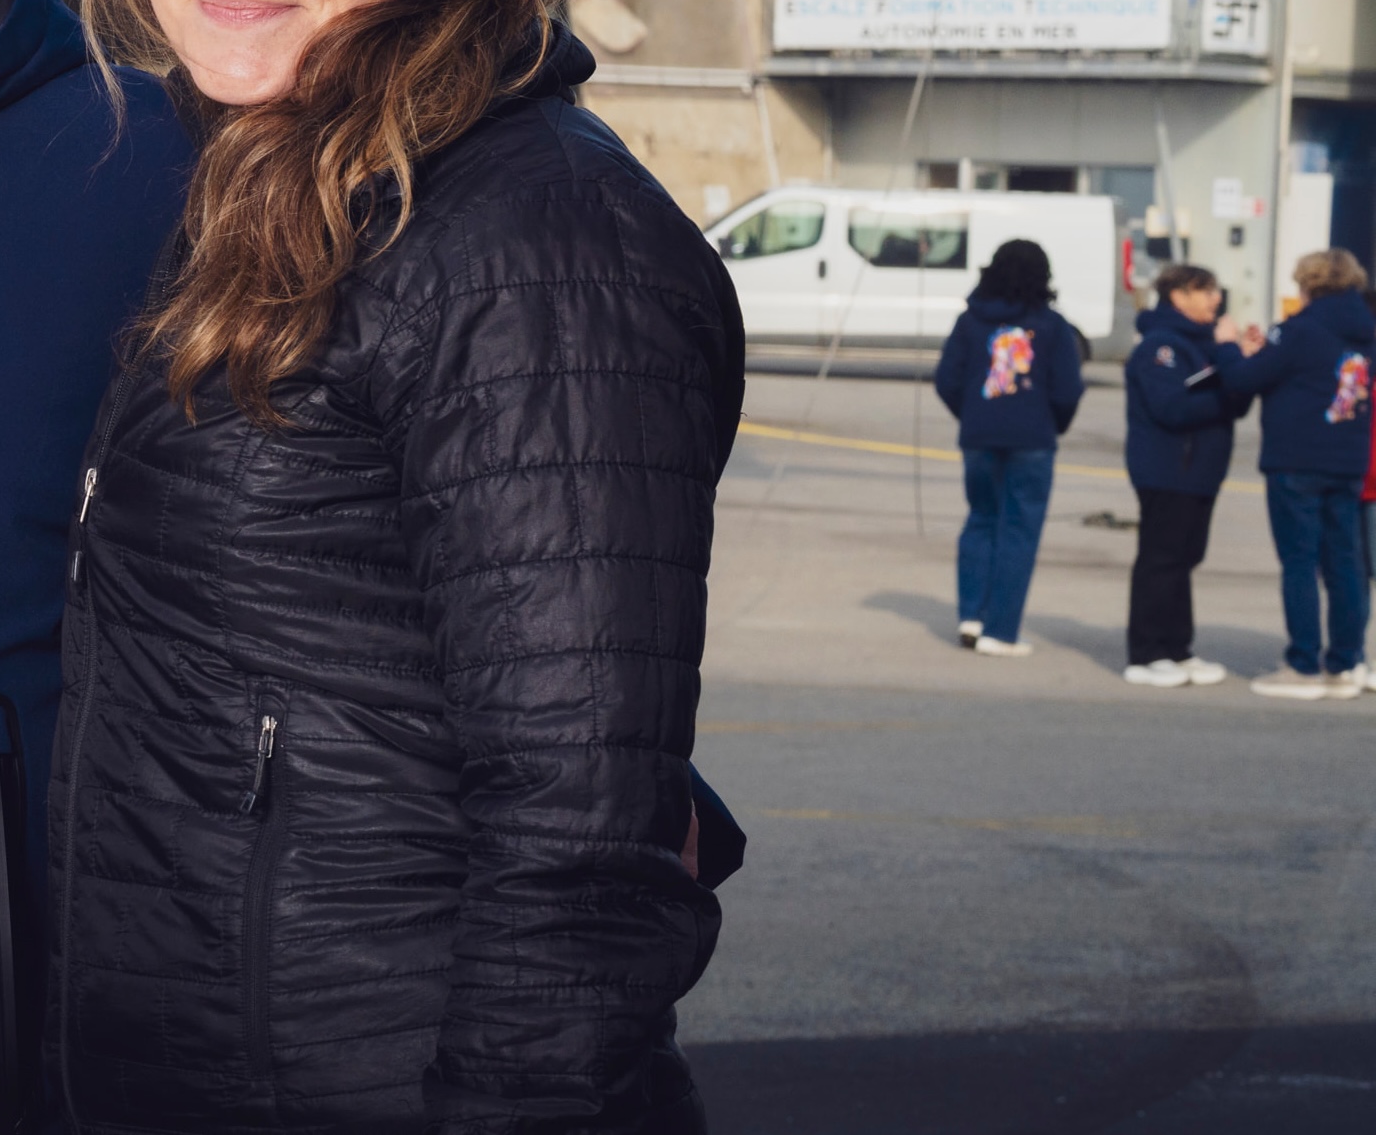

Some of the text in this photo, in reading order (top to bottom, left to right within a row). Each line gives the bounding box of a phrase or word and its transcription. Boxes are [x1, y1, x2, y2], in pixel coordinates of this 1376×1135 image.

[859, 22, 1077, 39] AUTONOMIE EN MER
